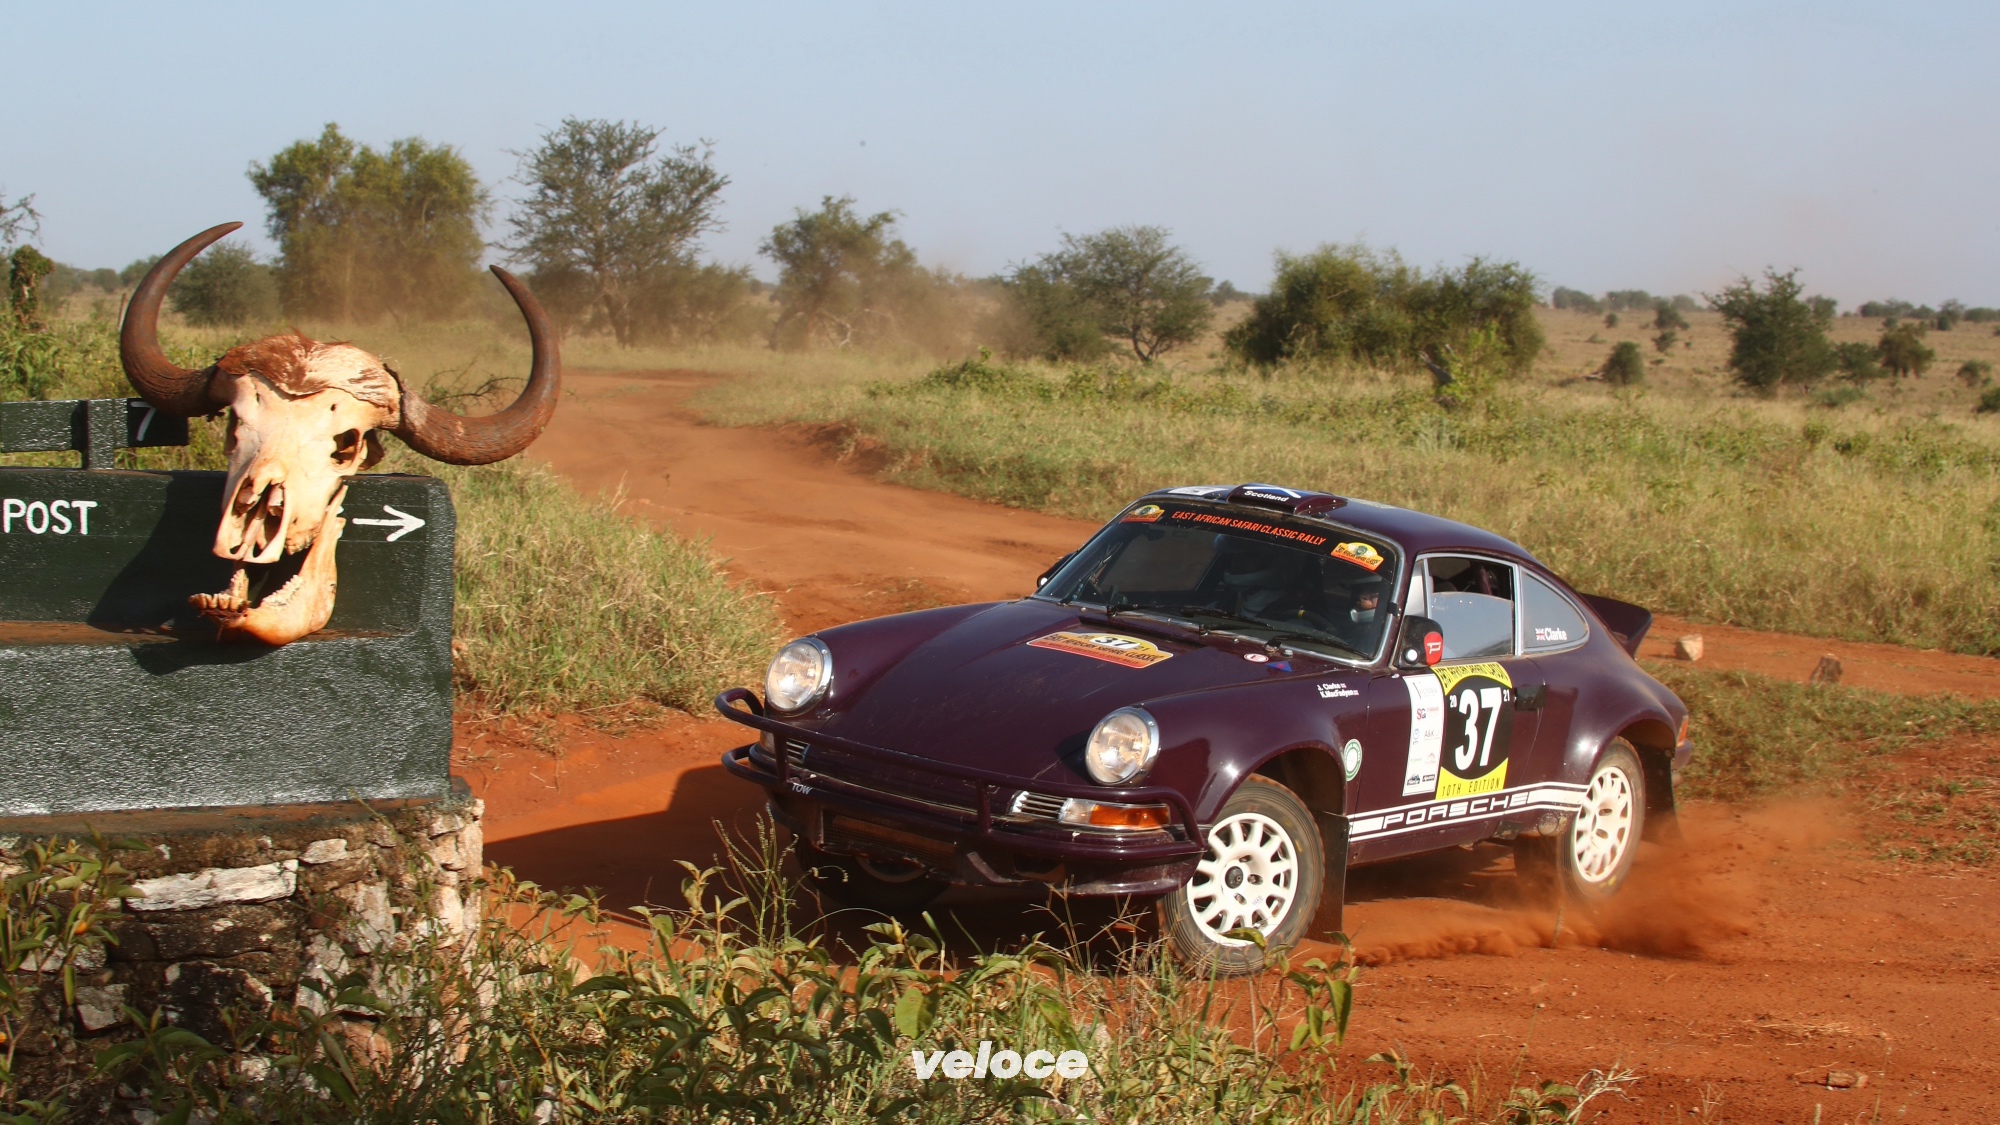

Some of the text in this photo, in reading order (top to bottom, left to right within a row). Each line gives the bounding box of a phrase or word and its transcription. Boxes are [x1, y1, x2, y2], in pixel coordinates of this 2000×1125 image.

[1244, 490, 1289, 502] Scotland
[3, 498, 98, 535] POST
[1171, 511, 1196, 521] EAST
[1194, 514, 1230, 526] AFRICAN
[1229, 519, 1261, 532] SAFARI
[1260, 524, 1298, 538] CLASSIC
[1297, 533, 1327, 546] RALLY
[1095, 636, 1138, 647] 37
[1544, 627, 1568, 641] Clarke
[1449, 694, 1458, 708] 20
[1455, 687, 1502, 771] 37
[1503, 689, 1511, 702] 21
[792, 782, 813, 794] TOW
[1441, 778, 1501, 797] 10TH EDITION
[1382, 791, 1531, 830] PORSCHE
